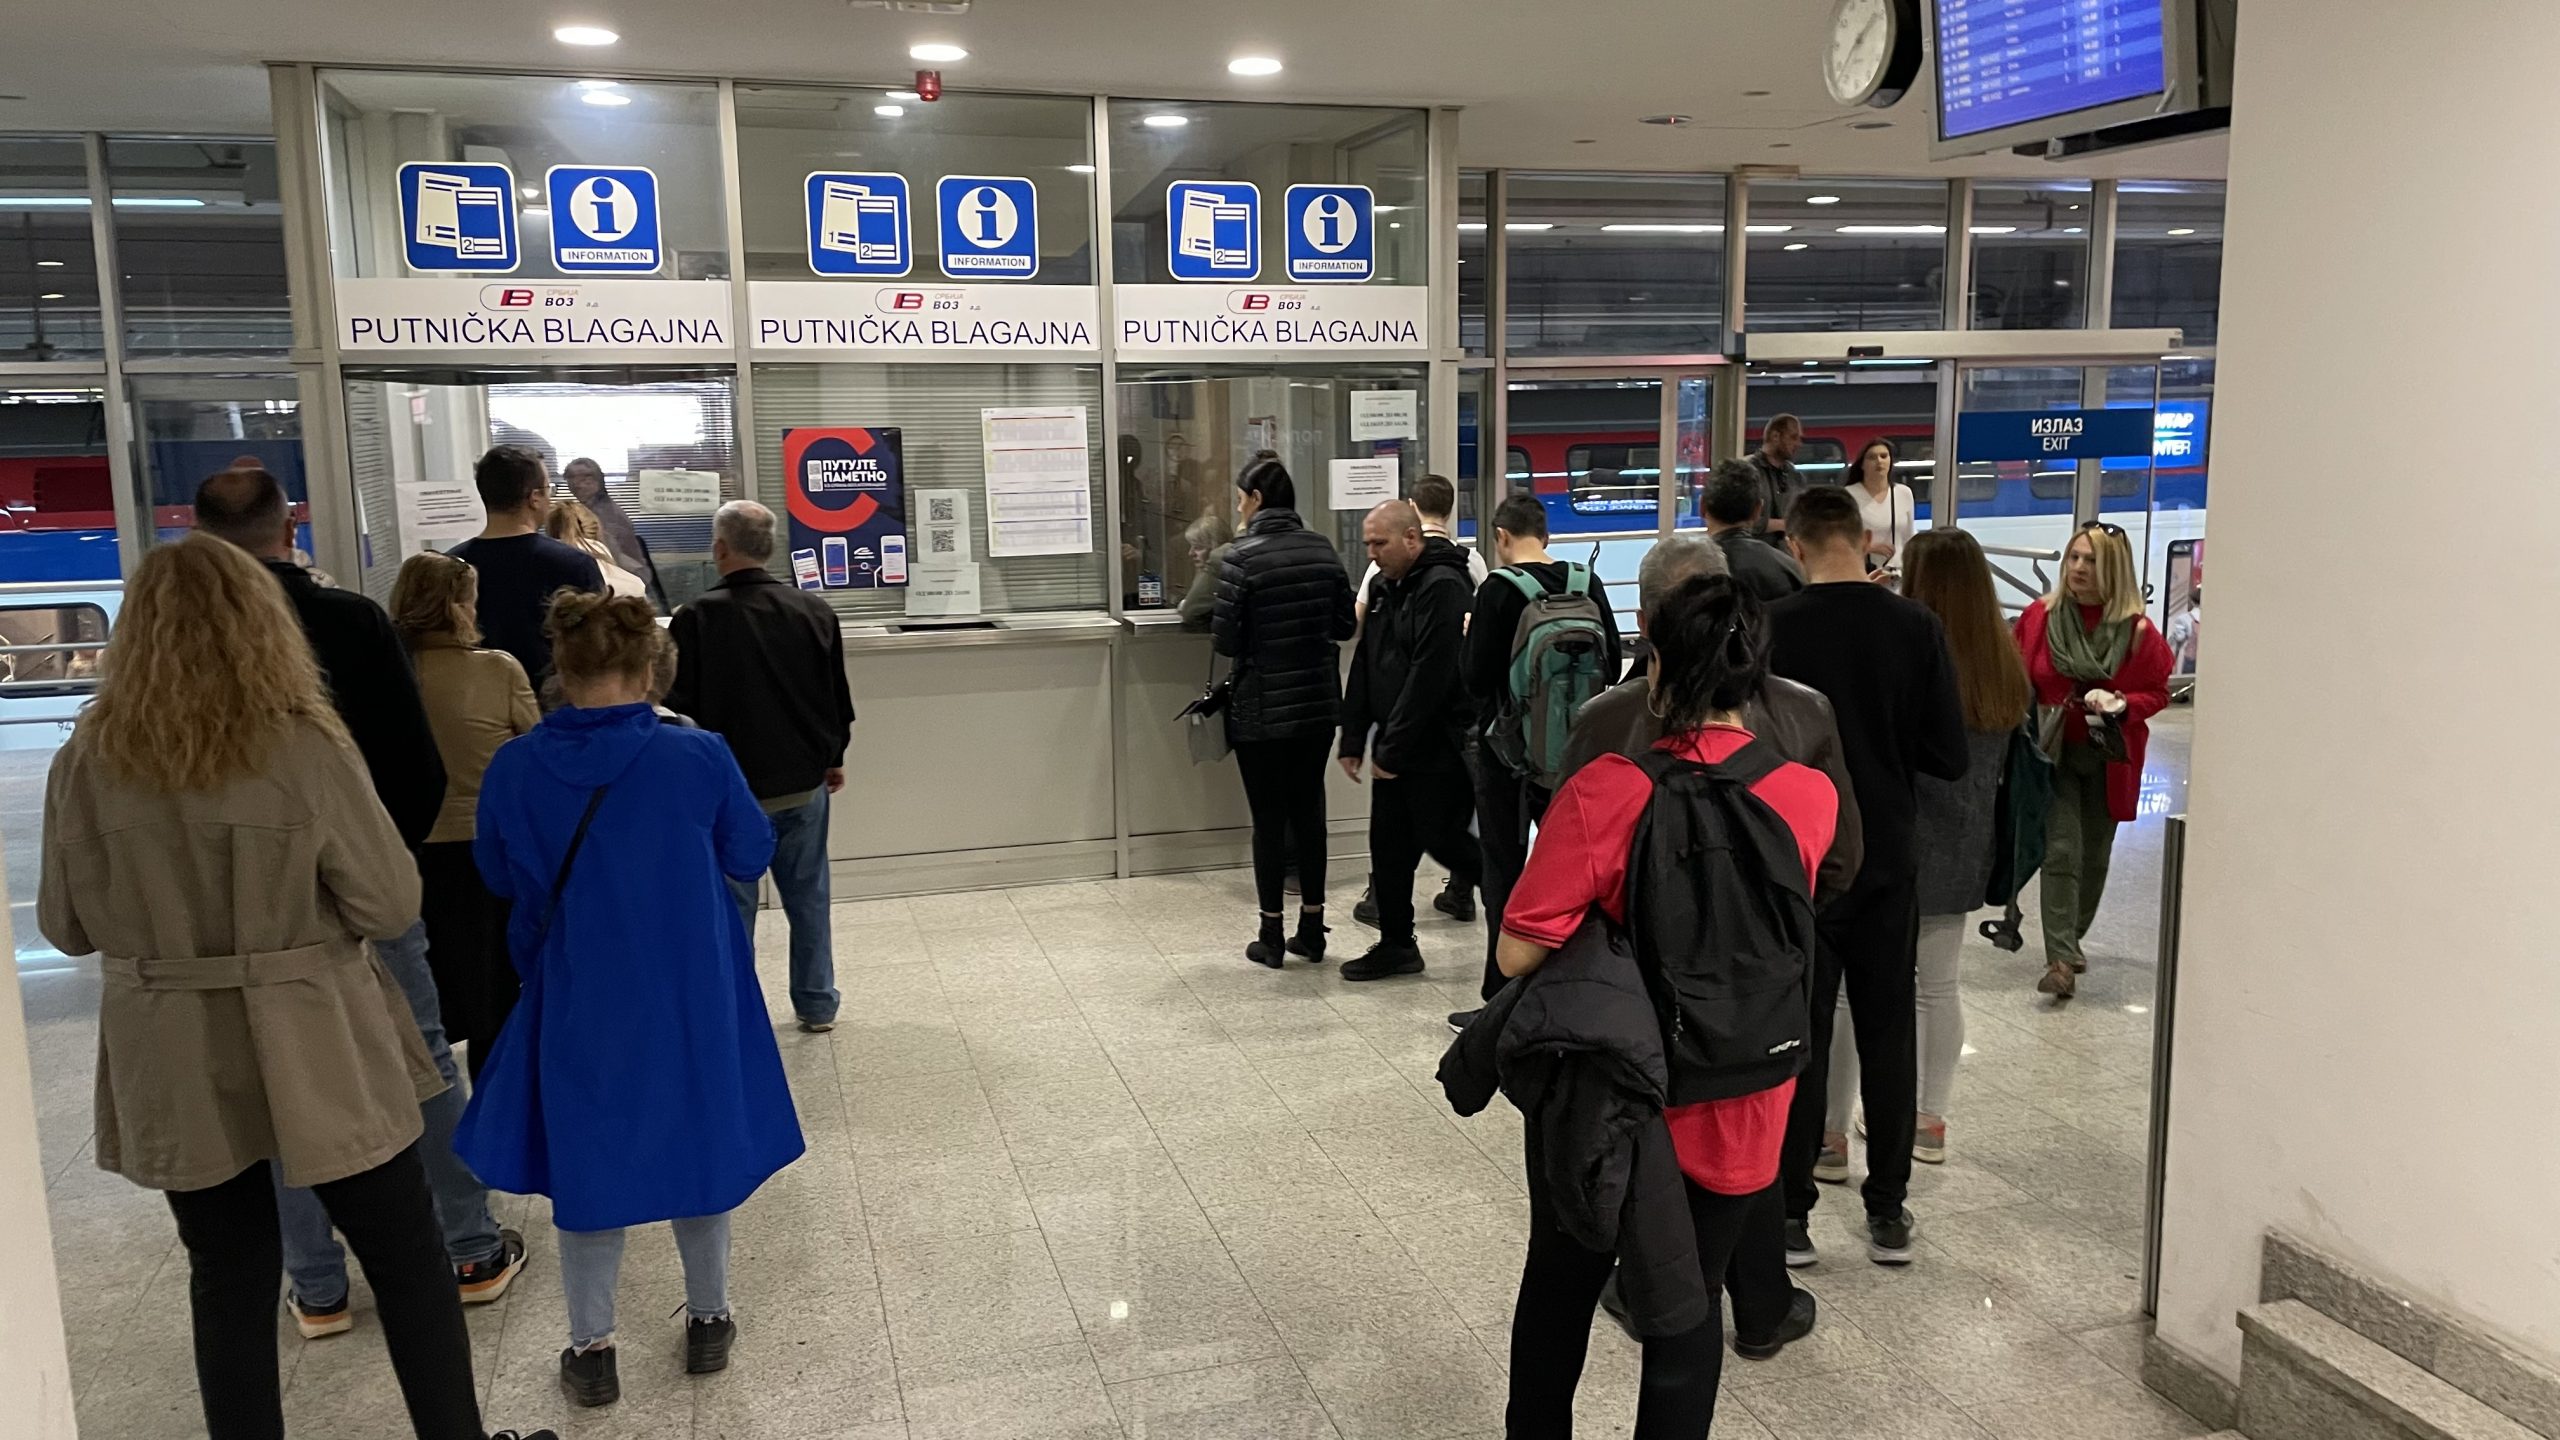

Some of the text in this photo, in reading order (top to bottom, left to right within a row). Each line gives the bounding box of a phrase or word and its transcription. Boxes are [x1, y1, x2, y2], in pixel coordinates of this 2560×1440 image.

[567, 250, 648, 261] INFORMATION
[953, 257, 1026, 267] INFORMATION
[1298, 261, 1363, 271] INFORMATION
[351, 312, 723, 344] PUTNIČKA BLAGAJNA
[761, 314, 1091, 345] PUTNIČKA BLAGAJNA
[1124, 314, 1418, 343] PUTNIČKA BLAGAJNA
[2031, 417, 2083, 434] ИЗЛАЗ
[2042, 437, 2071, 451] EXIT
[822, 459, 878, 471] ПУТУЈТЕ
[823, 470, 887, 483] ПАМЕТНО
